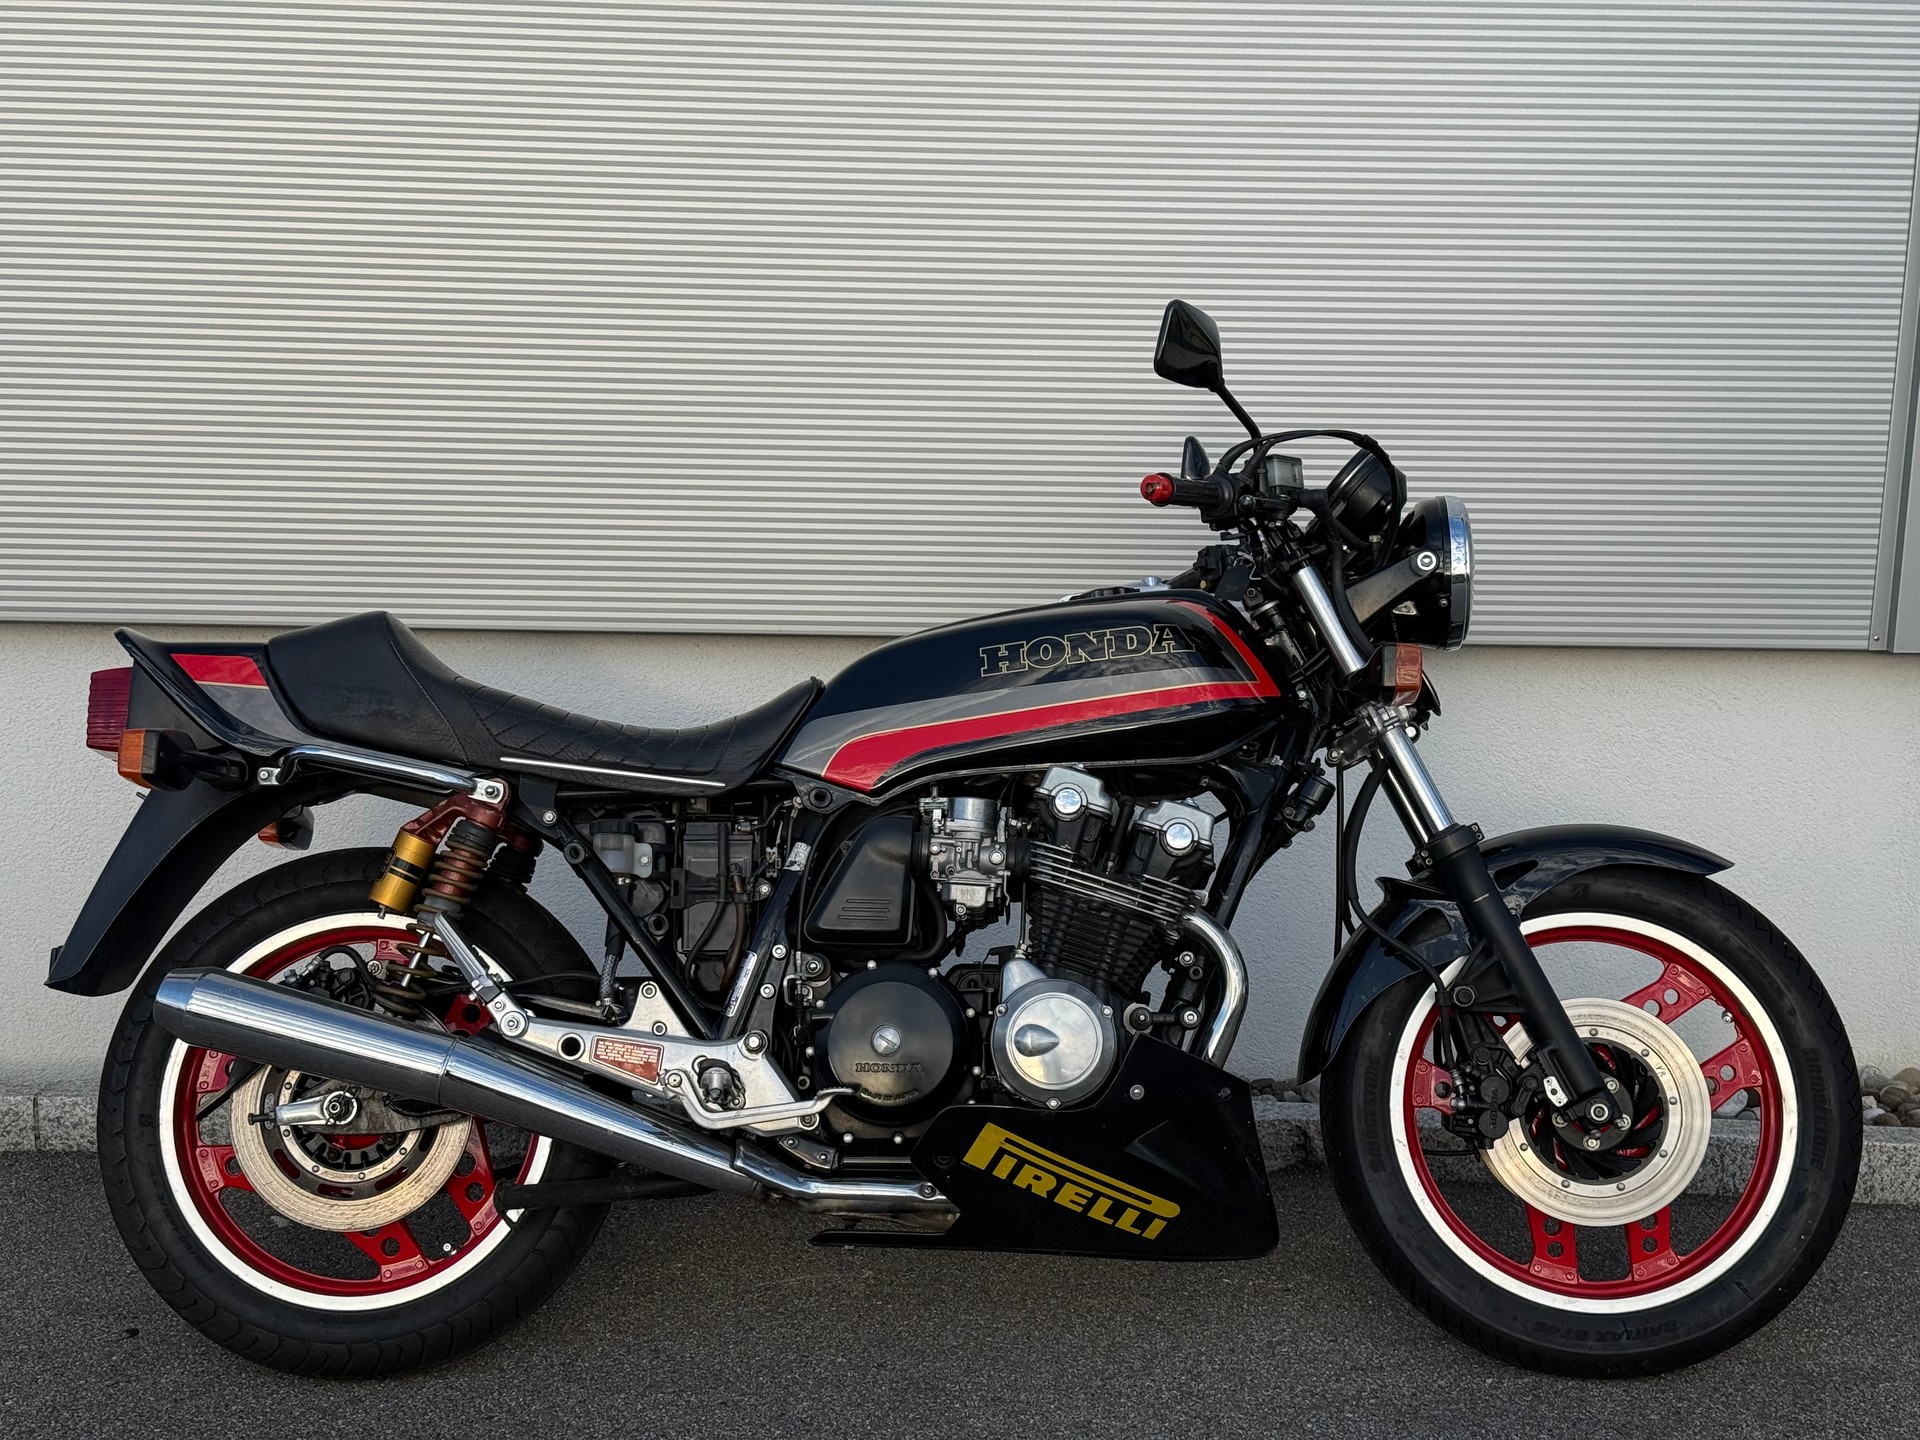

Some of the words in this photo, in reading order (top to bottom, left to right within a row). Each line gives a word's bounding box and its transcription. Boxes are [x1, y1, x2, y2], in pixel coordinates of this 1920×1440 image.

[979, 624, 1196, 678] HONDA
[855, 1062, 924, 1073] HONDA
[962, 1122, 1181, 1240] PIRELLI
